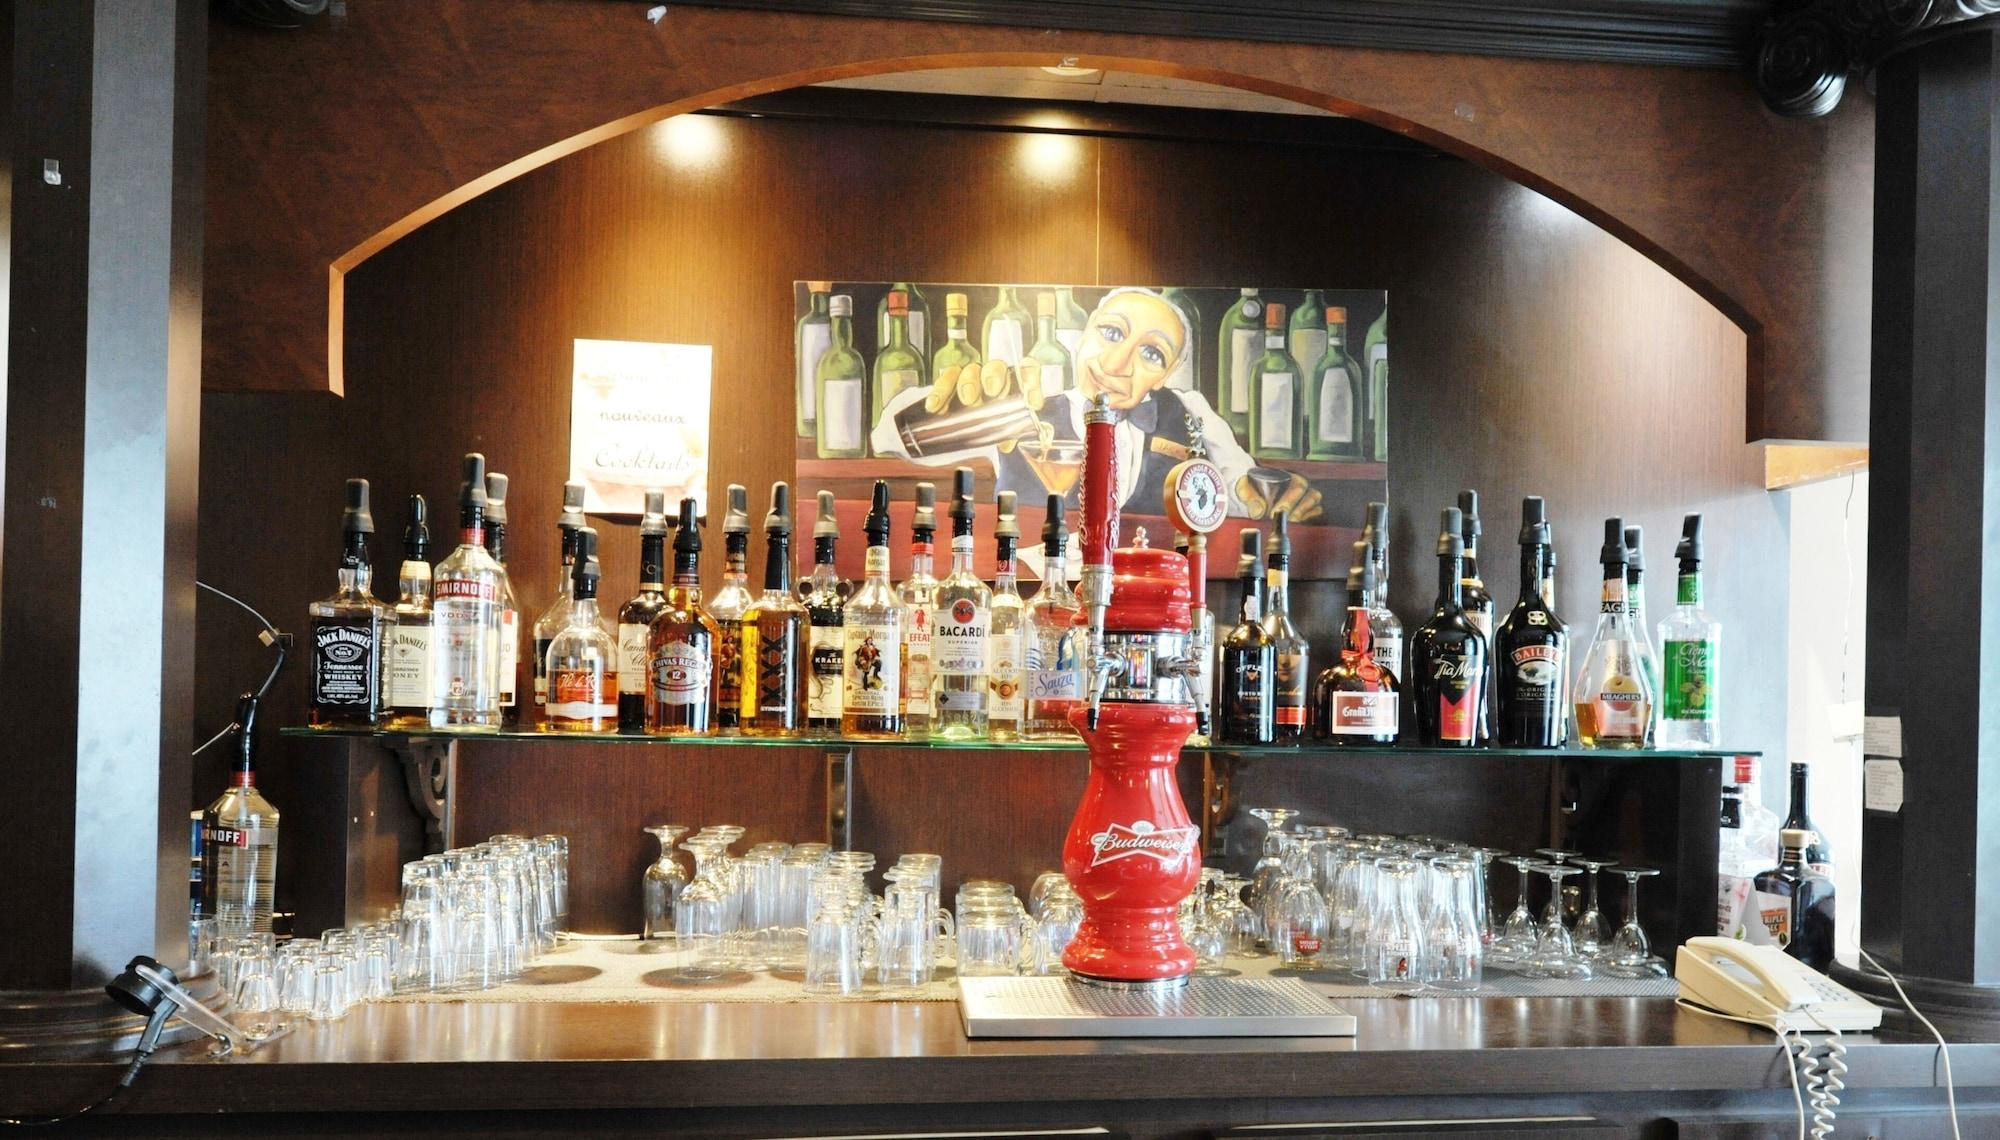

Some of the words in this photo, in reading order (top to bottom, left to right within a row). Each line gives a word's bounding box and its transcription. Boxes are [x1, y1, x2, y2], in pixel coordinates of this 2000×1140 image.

[599, 409, 688, 425] nouveaux
[317, 631, 339, 648] JACK
[909, 632, 930, 642] EFEA
[323, 661, 364, 670] Tennessee
[1451, 661, 1483, 679] Mar
[323, 673, 363, 681] WHISKEY
[672, 670, 681, 680] 12
[1035, 673, 1075, 697] Sauza
[1098, 833, 1192, 852] Budweiser
